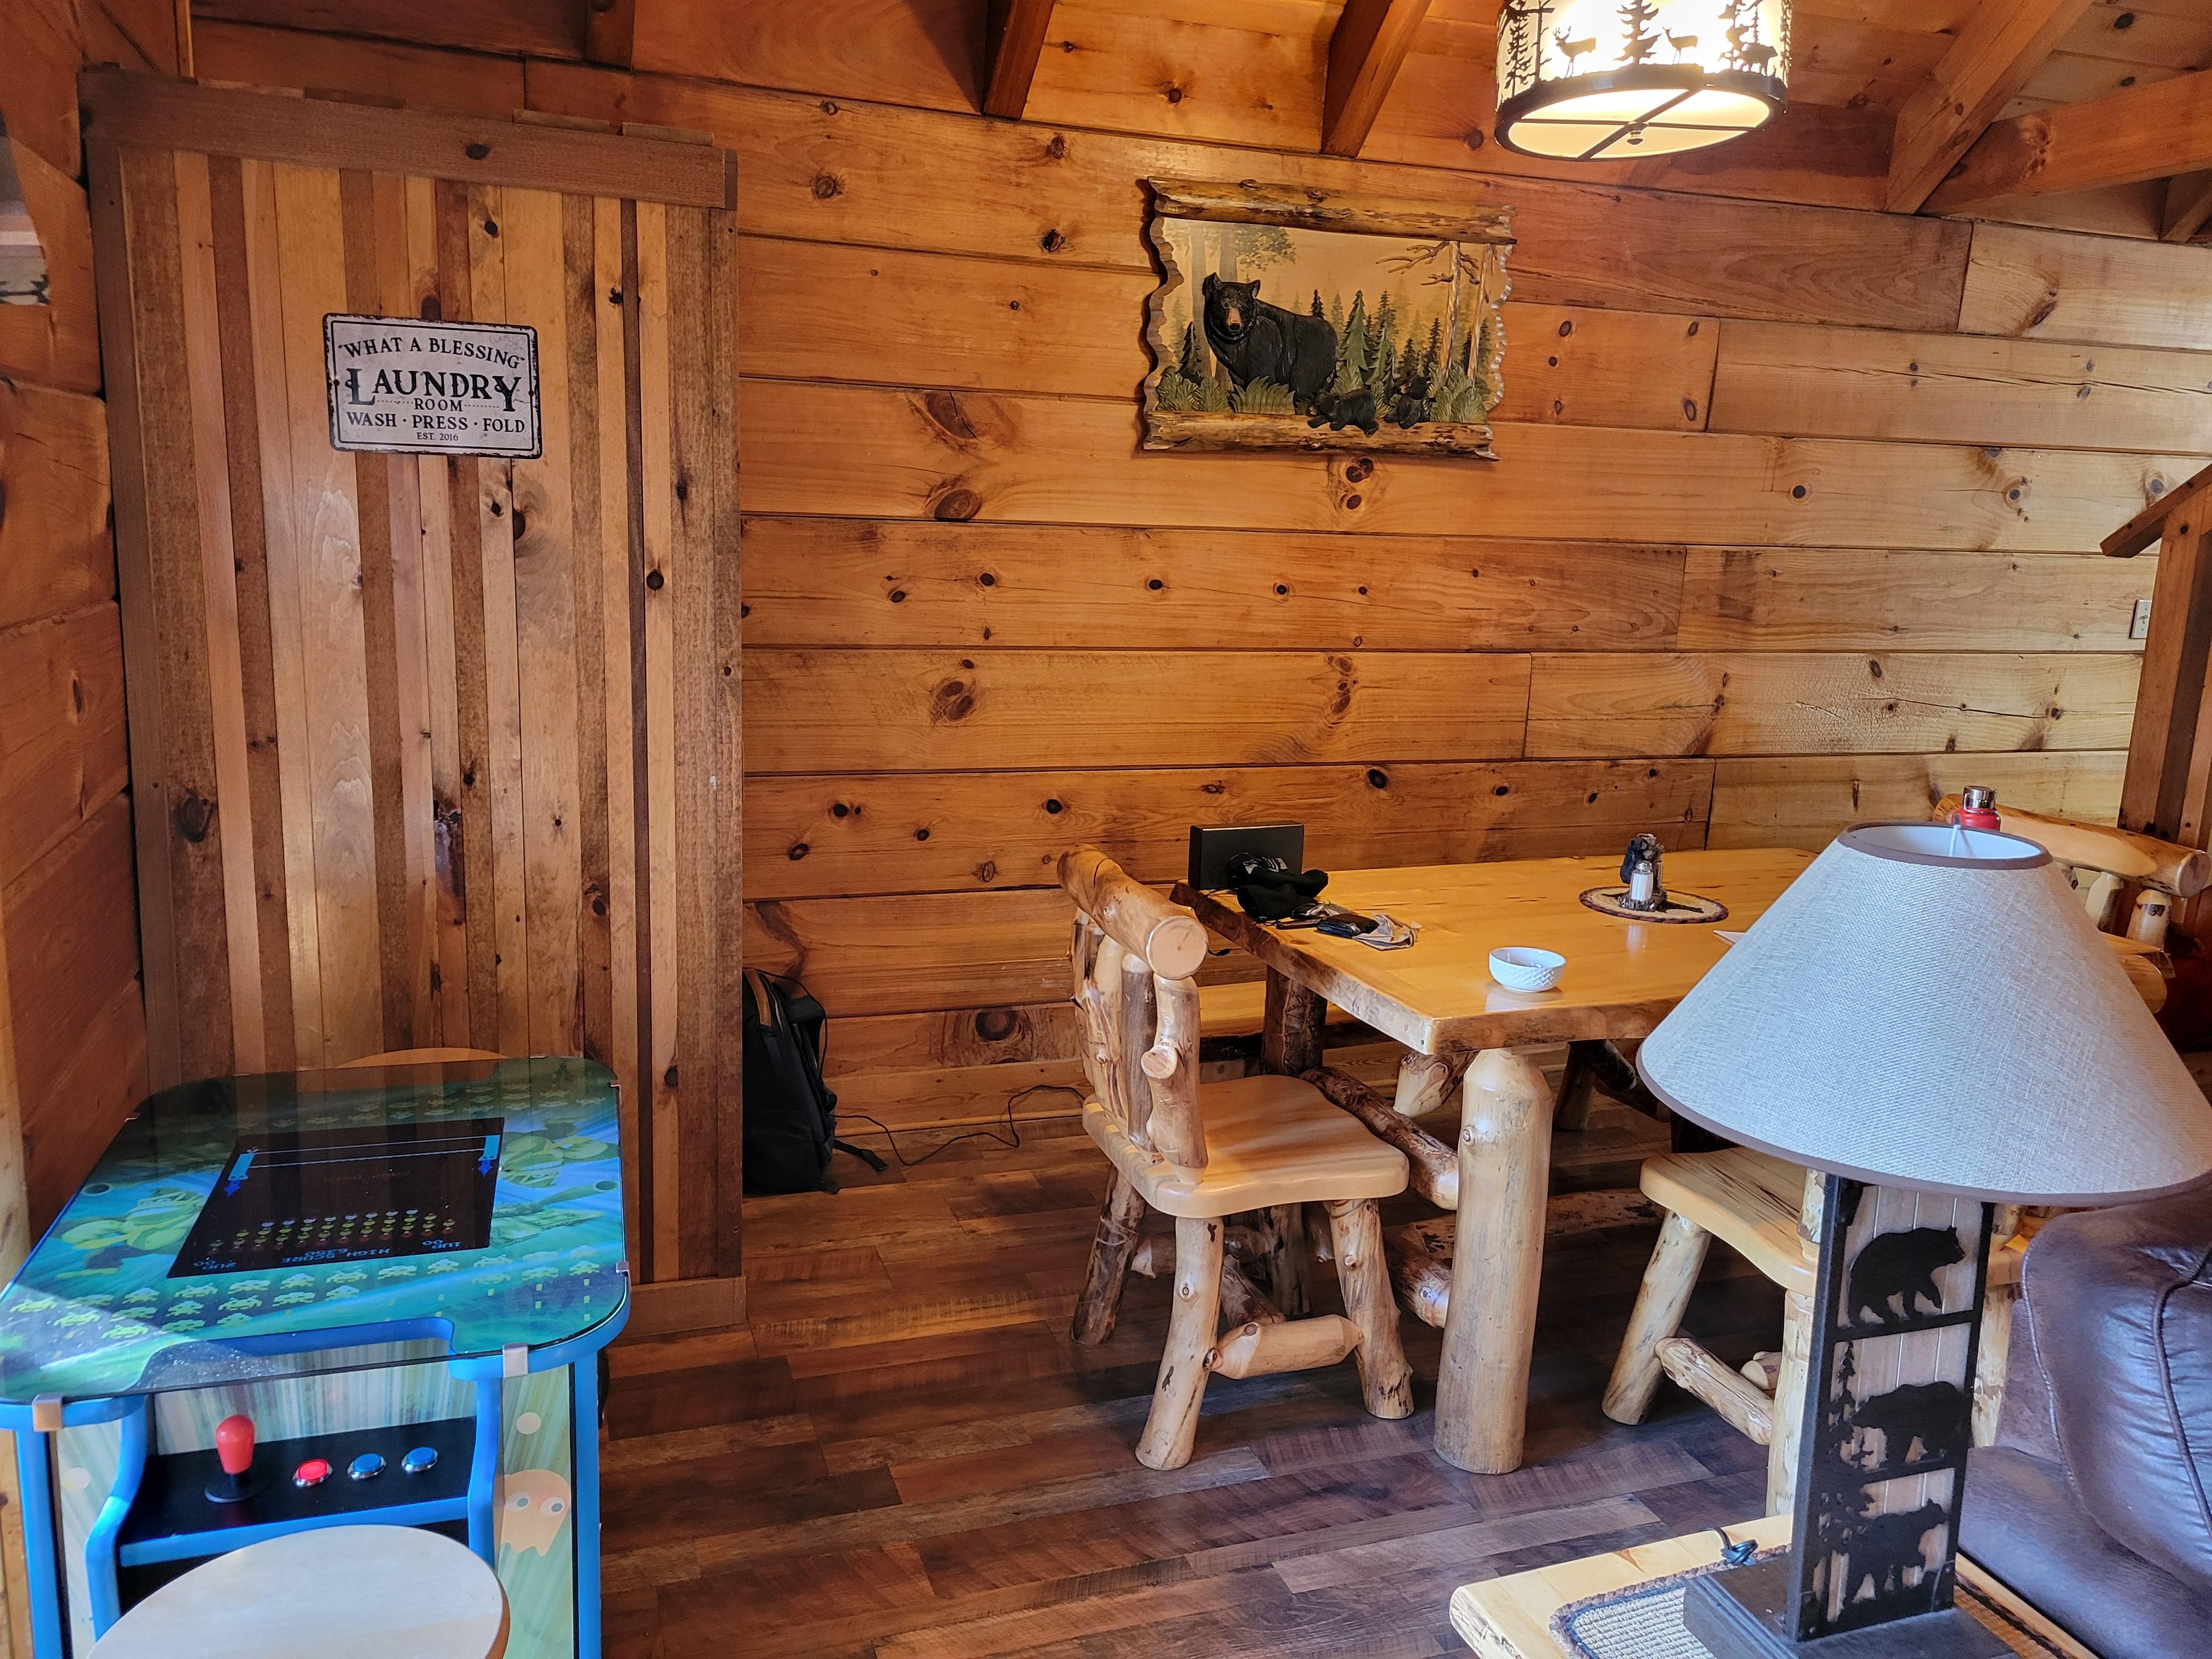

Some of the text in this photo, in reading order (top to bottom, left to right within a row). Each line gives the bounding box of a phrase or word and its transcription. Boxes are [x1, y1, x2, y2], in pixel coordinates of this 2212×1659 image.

[409, 337, 422, 352] A
[345, 368, 522, 411] LAUNDRY
[414, 398, 464, 412] ROOM
[346, 412, 525, 433] WASH PRESS FOLD
[439, 433, 459, 442] 2016
[346, 1248, 391, 1257] HIGH
